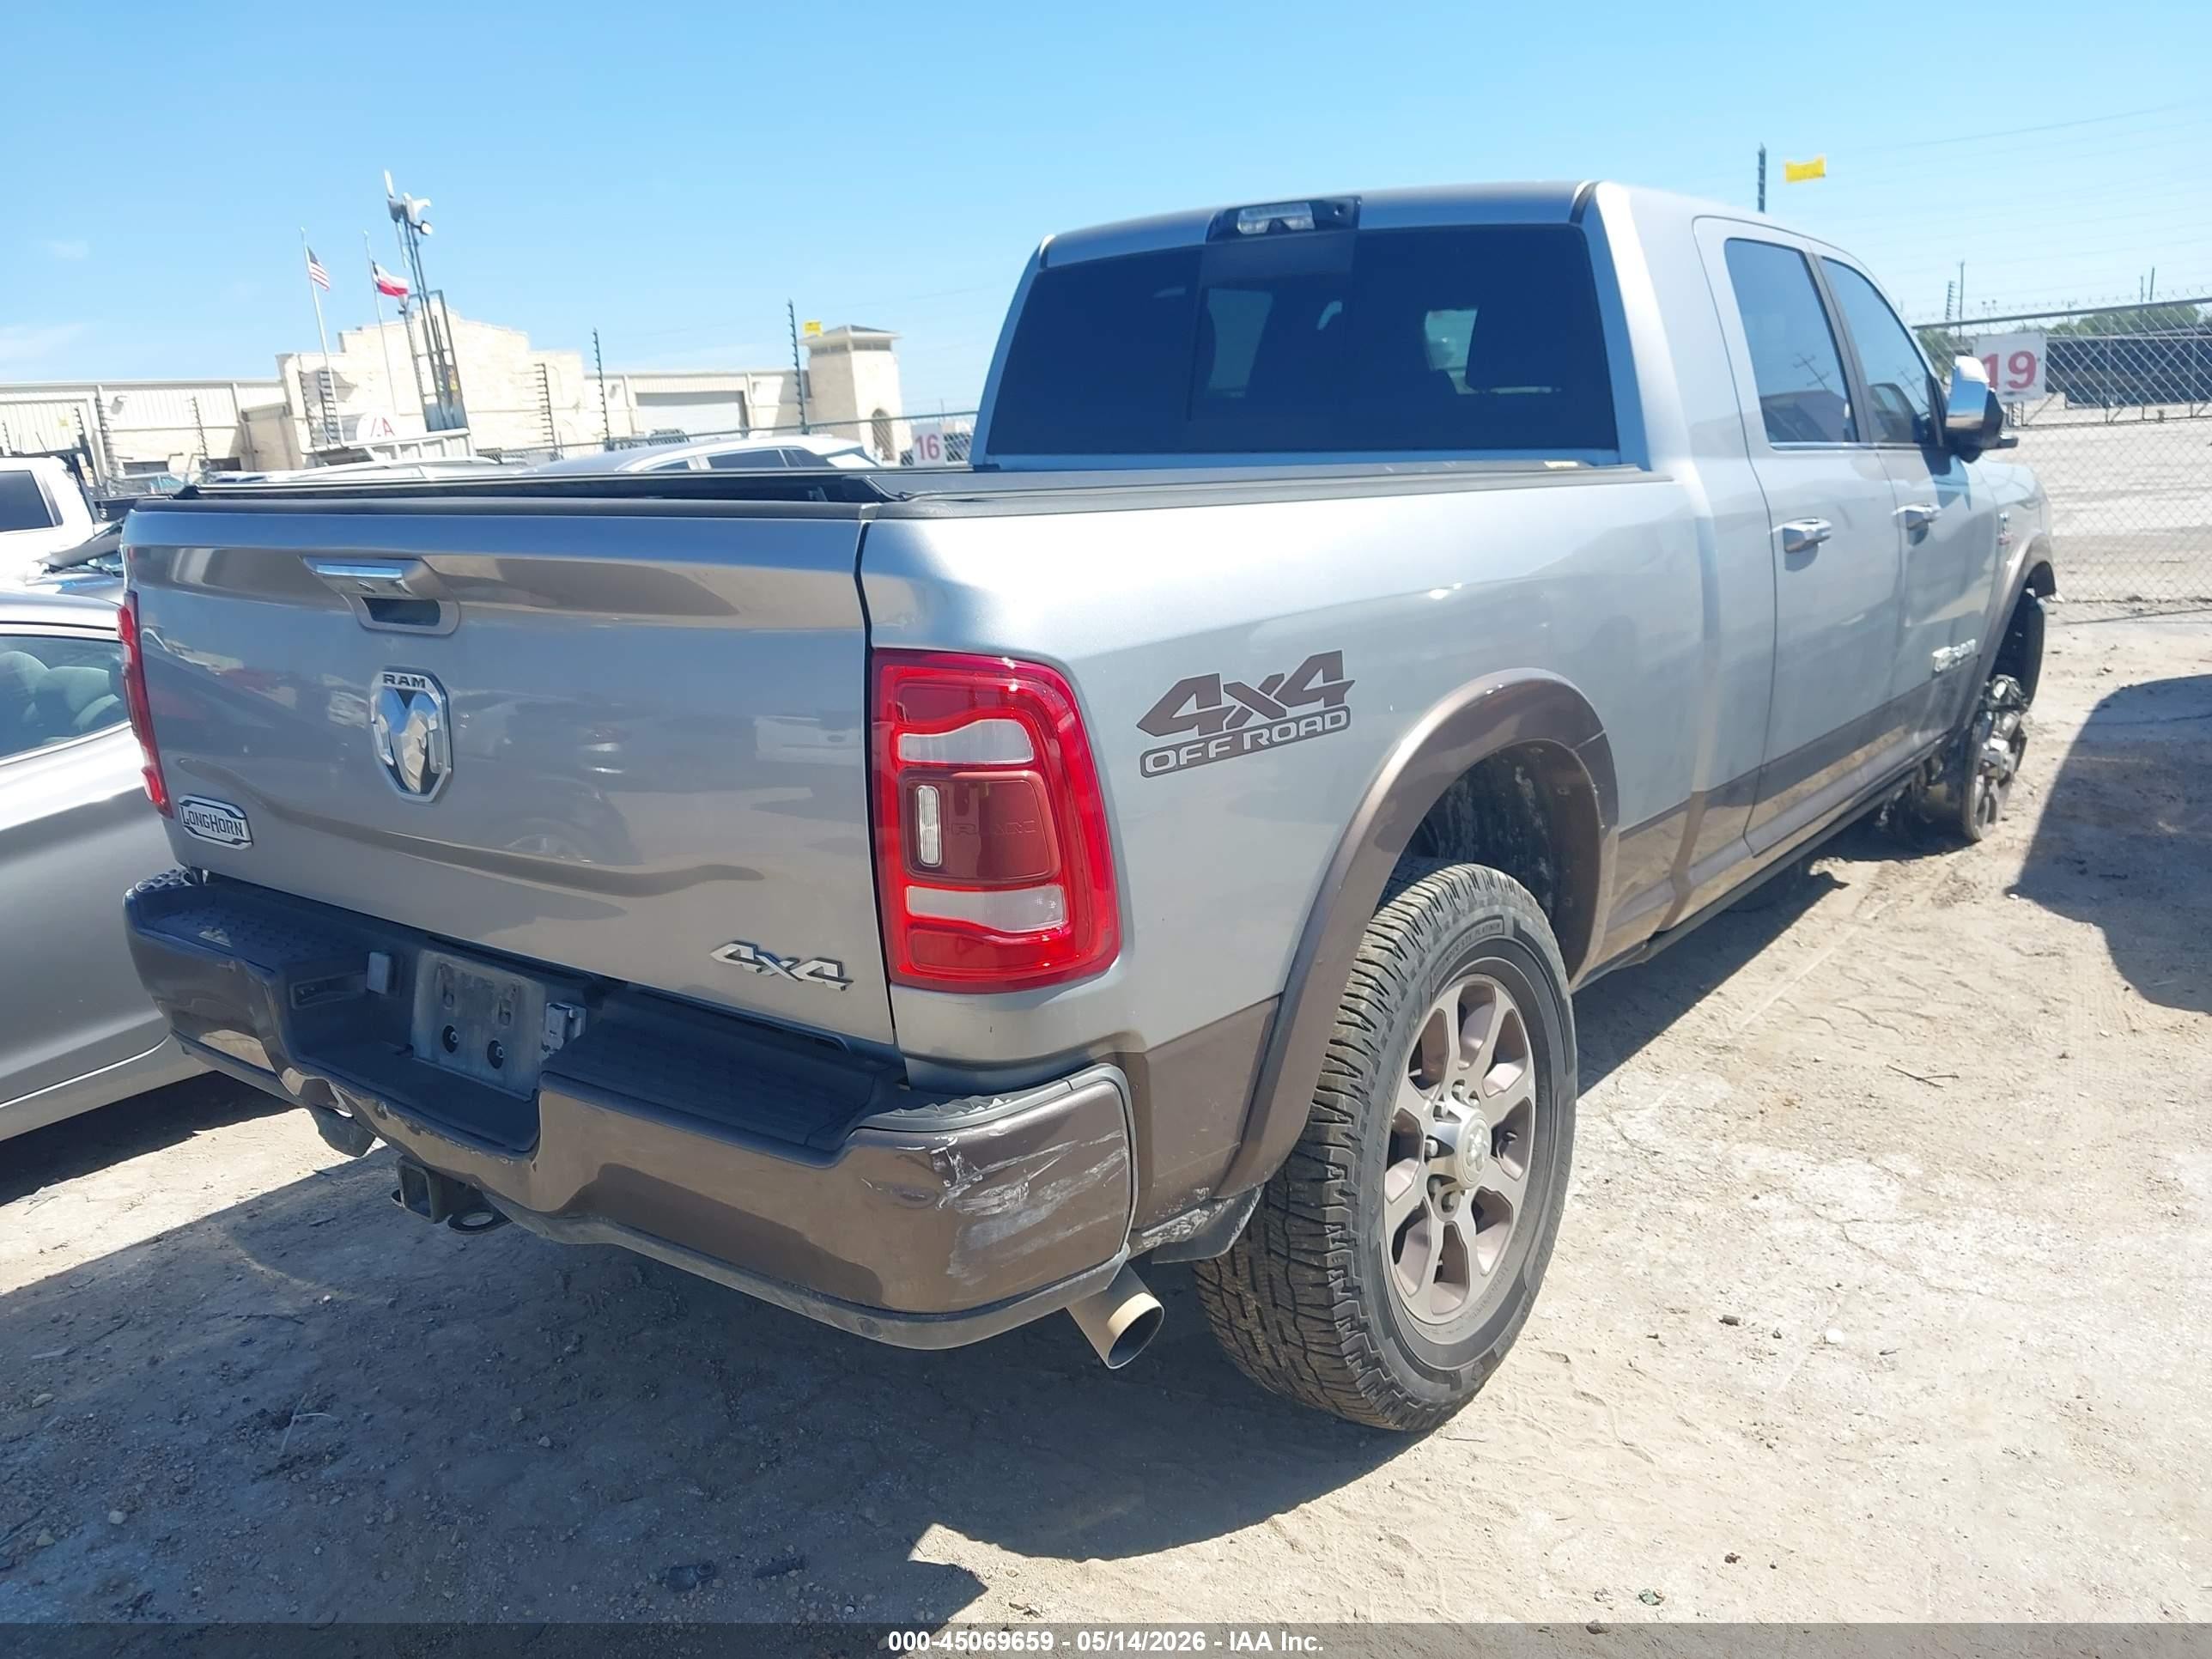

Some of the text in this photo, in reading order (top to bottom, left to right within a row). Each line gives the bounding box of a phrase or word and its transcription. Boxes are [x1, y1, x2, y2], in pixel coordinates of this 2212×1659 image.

[1982, 351, 2036, 389] 19
[915, 434, 940, 460] 16
[383, 674, 426, 688] RAM
[1145, 710, 1347, 773] OFF ROAD
